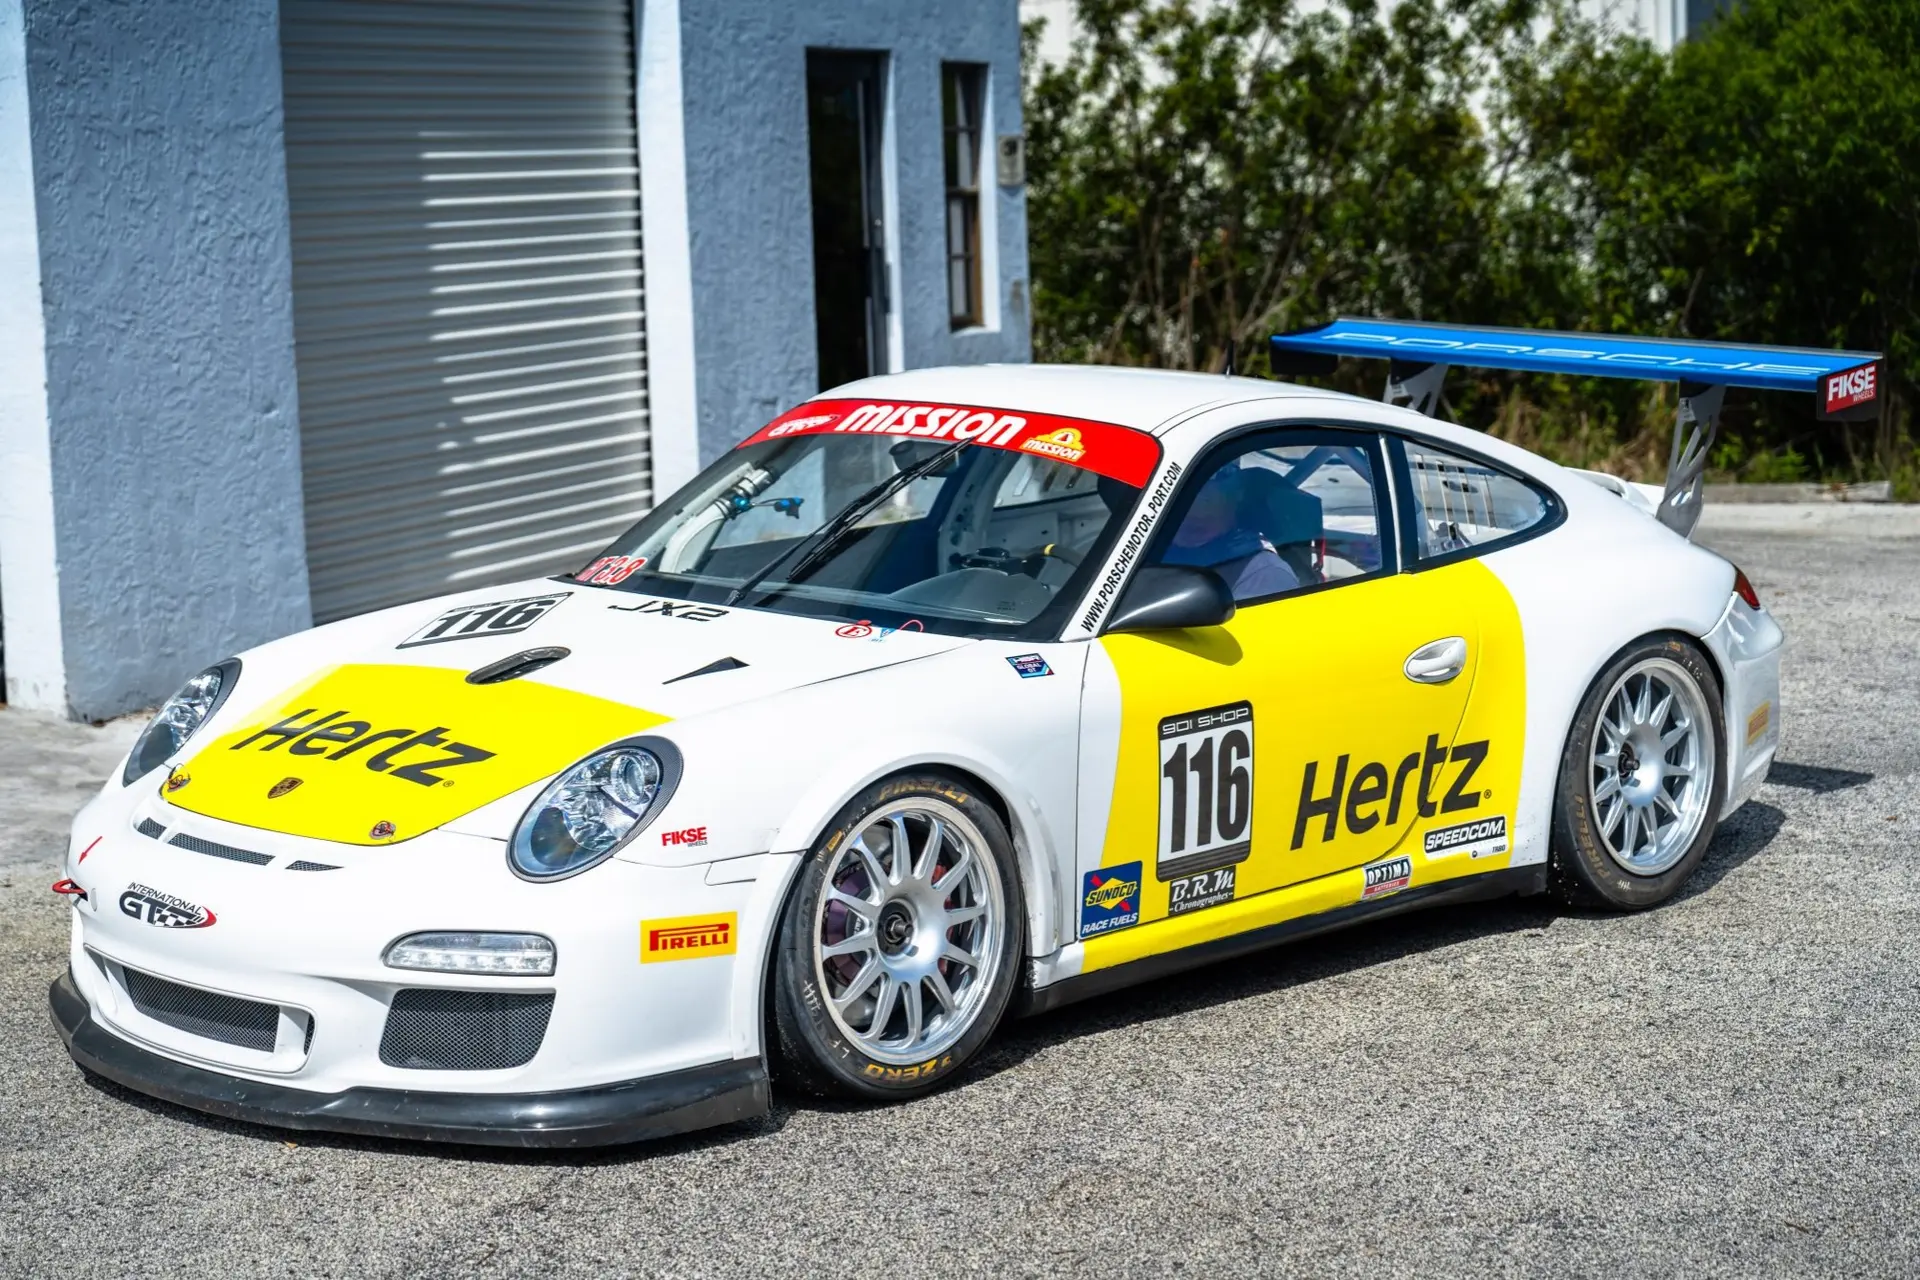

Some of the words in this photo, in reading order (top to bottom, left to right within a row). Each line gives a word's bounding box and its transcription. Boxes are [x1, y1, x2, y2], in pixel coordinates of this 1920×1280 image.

[1322, 333, 1830, 377] PORSCHE
[1828, 366, 1876, 401] FIKSE
[1853, 389, 1874, 402] WHEELS
[1081, 461, 1182, 633] WWW.PORSCHEMOTORPORT.COM
[422, 600, 556, 639] 116
[607, 600, 730, 622] JX2
[1198, 708, 1249, 728] SHOP
[229, 709, 498, 787] Hertz
[1163, 729, 1250, 854] 116
[1290, 733, 1490, 851] Hertz
[661, 827, 707, 846] FIKSE
[1368, 861, 1409, 885] OPTIMA
[127, 882, 202, 916] INTERNATIONAL
[1088, 883, 1135, 905] SUNOCO
[649, 923, 730, 951] PIRELLI
[1082, 920, 1109, 935] RACE
[1109, 912, 1138, 928] FUELS
[863, 1060, 938, 1081] ZERO
